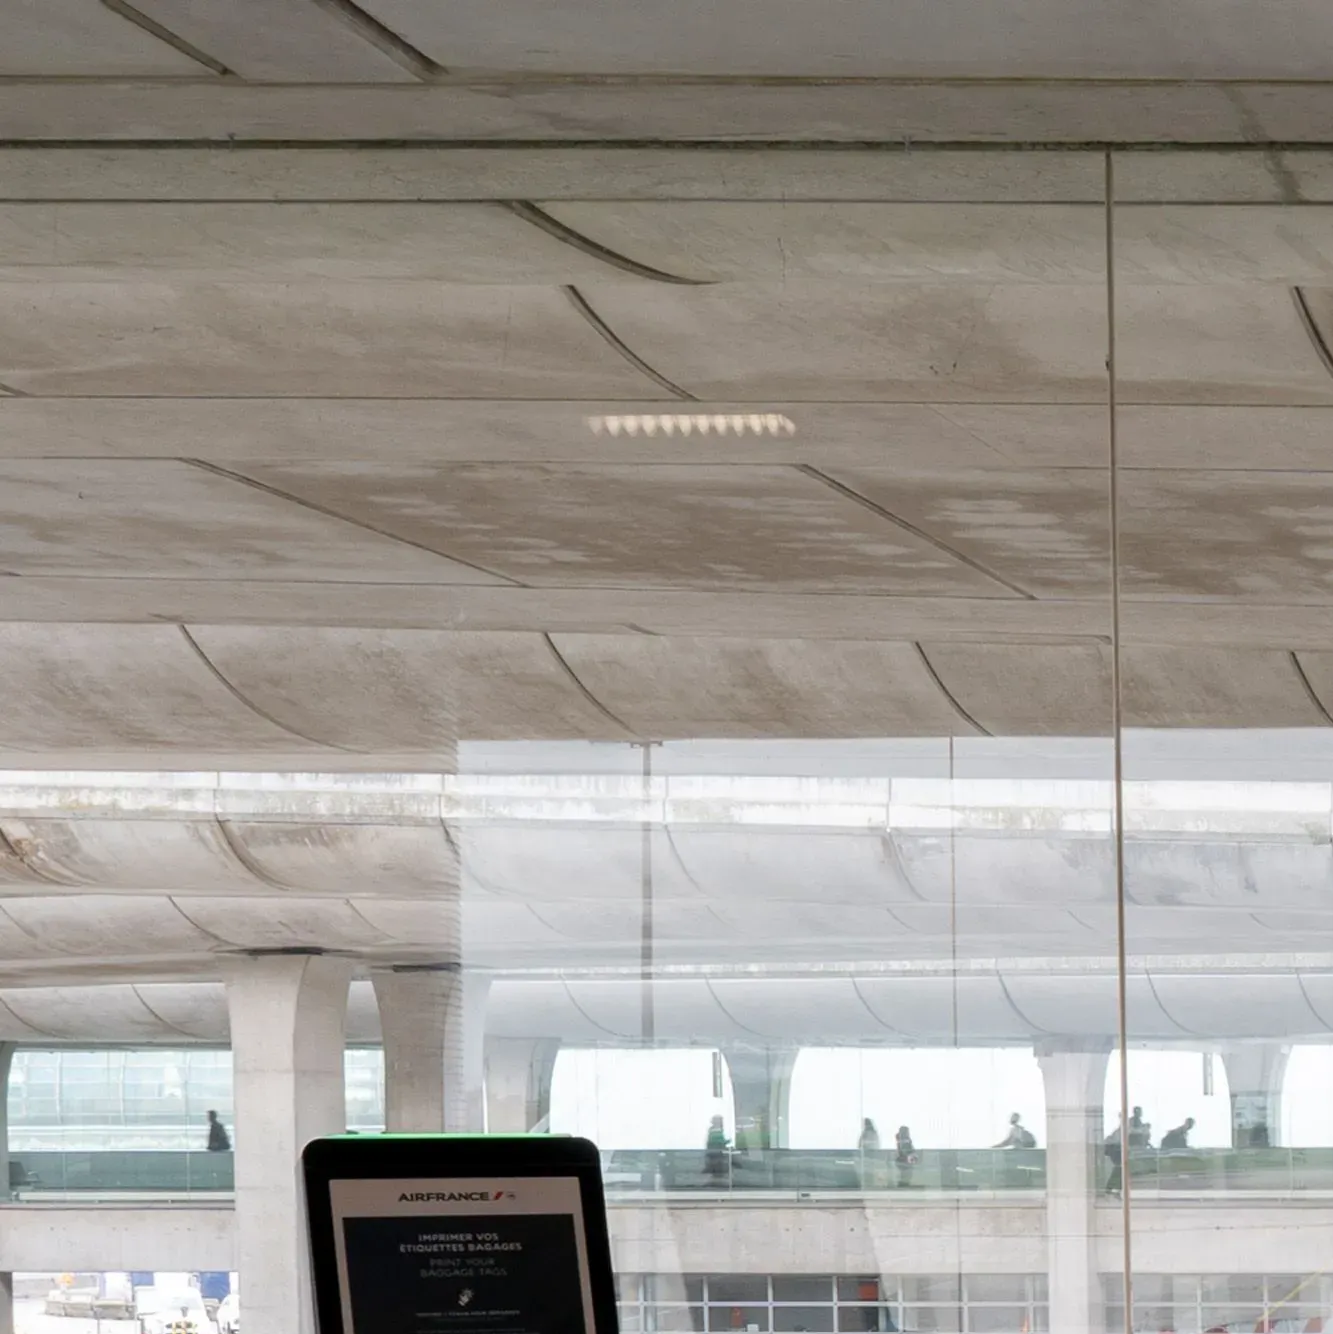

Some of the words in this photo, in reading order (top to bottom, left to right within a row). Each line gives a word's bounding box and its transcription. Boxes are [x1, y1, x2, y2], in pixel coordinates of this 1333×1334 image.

[397, 1191, 490, 1203] AIRFRANCE
[418, 1233, 473, 1242] IMPRIMER
[476, 1232, 499, 1241] VOS
[467, 1242, 522, 1252] BAGAGES
[466, 1257, 495, 1266] YOUR
